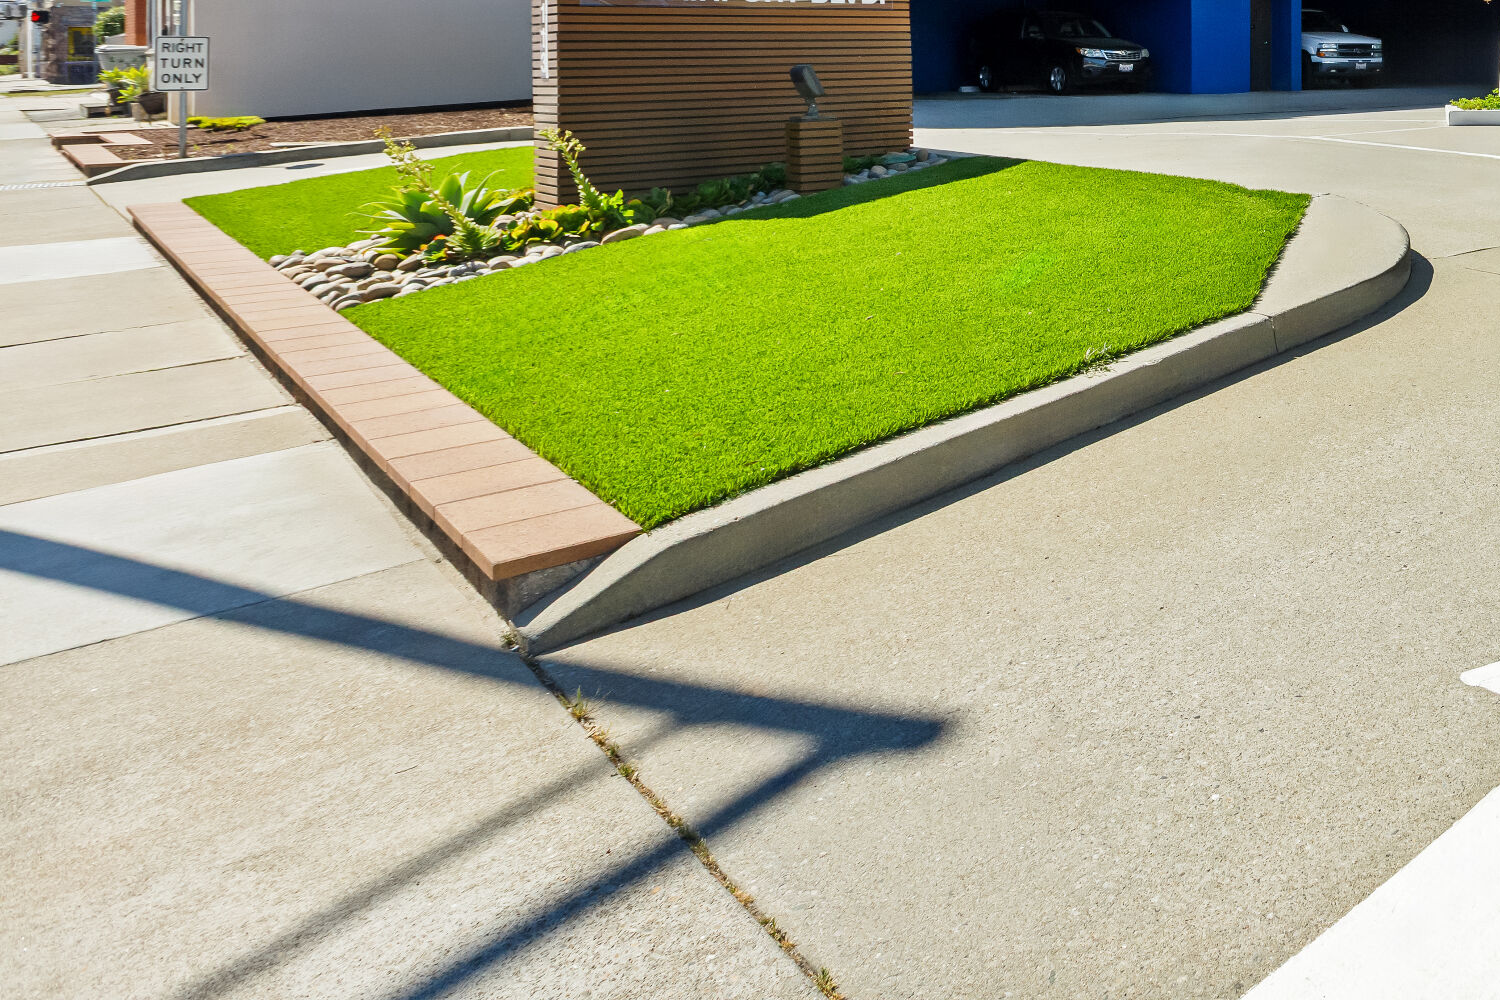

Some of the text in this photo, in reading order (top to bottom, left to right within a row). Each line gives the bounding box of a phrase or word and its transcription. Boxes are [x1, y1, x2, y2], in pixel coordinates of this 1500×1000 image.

[161, 42, 204, 53] RIGHT
[160, 58, 205, 69] TURN
[161, 73, 202, 84] ONLY
